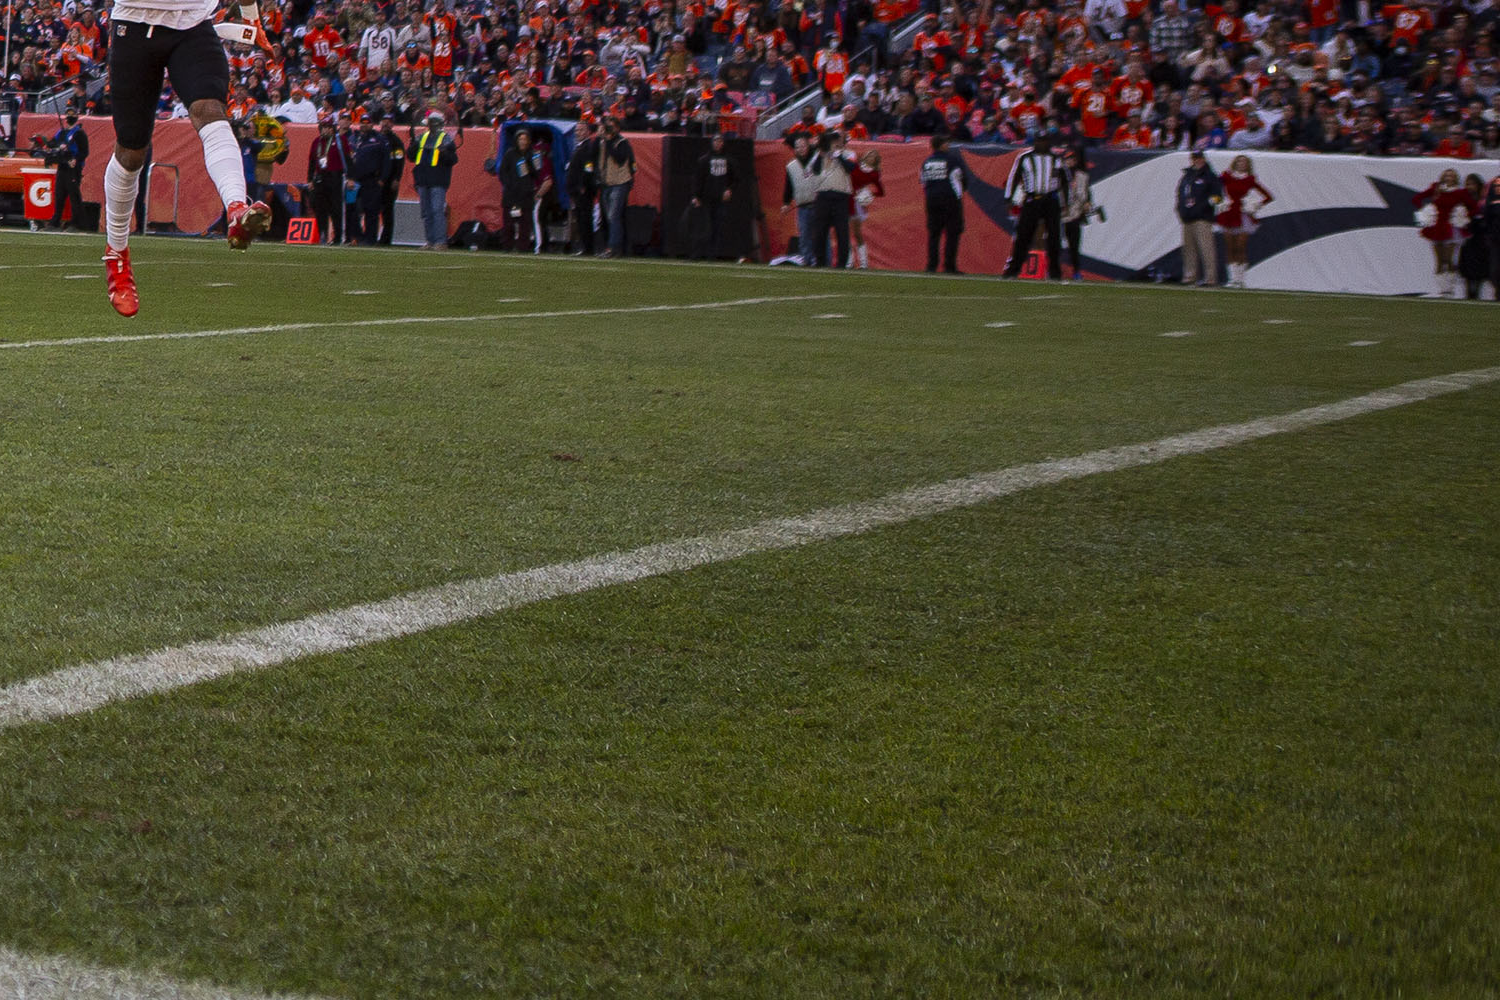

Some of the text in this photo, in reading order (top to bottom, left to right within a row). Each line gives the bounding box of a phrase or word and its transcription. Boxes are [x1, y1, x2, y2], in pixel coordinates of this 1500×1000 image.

[371, 37, 388, 49] 58
[29, 181, 52, 207] G
[289, 221, 312, 241] 20
